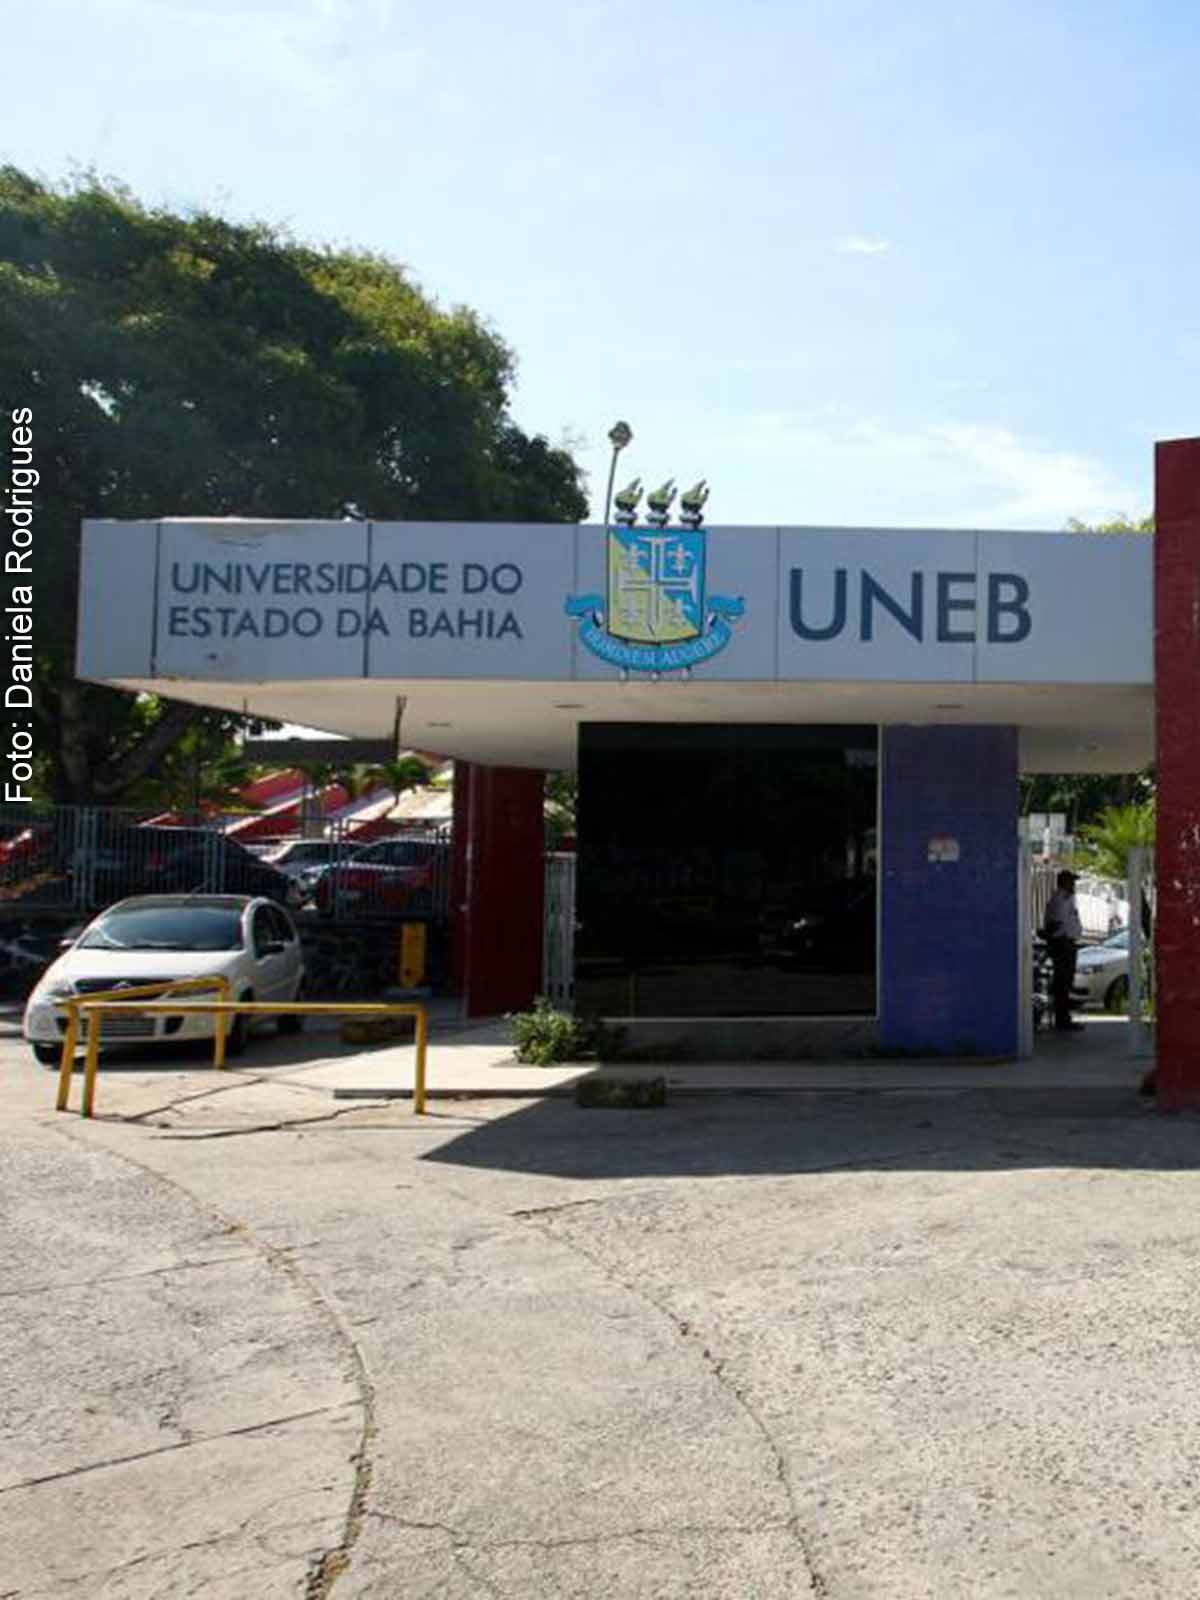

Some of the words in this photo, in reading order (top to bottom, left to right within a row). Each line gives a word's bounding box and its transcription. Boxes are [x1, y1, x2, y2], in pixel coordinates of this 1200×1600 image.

[172, 562, 448, 594] UNIVERSIDADE
[462, 563, 522, 594] DO
[168, 605, 323, 638] ESTADO
[336, 607, 390, 638] DA
[408, 607, 523, 639] BAHIA
[788, 567, 1032, 644] UNEB
